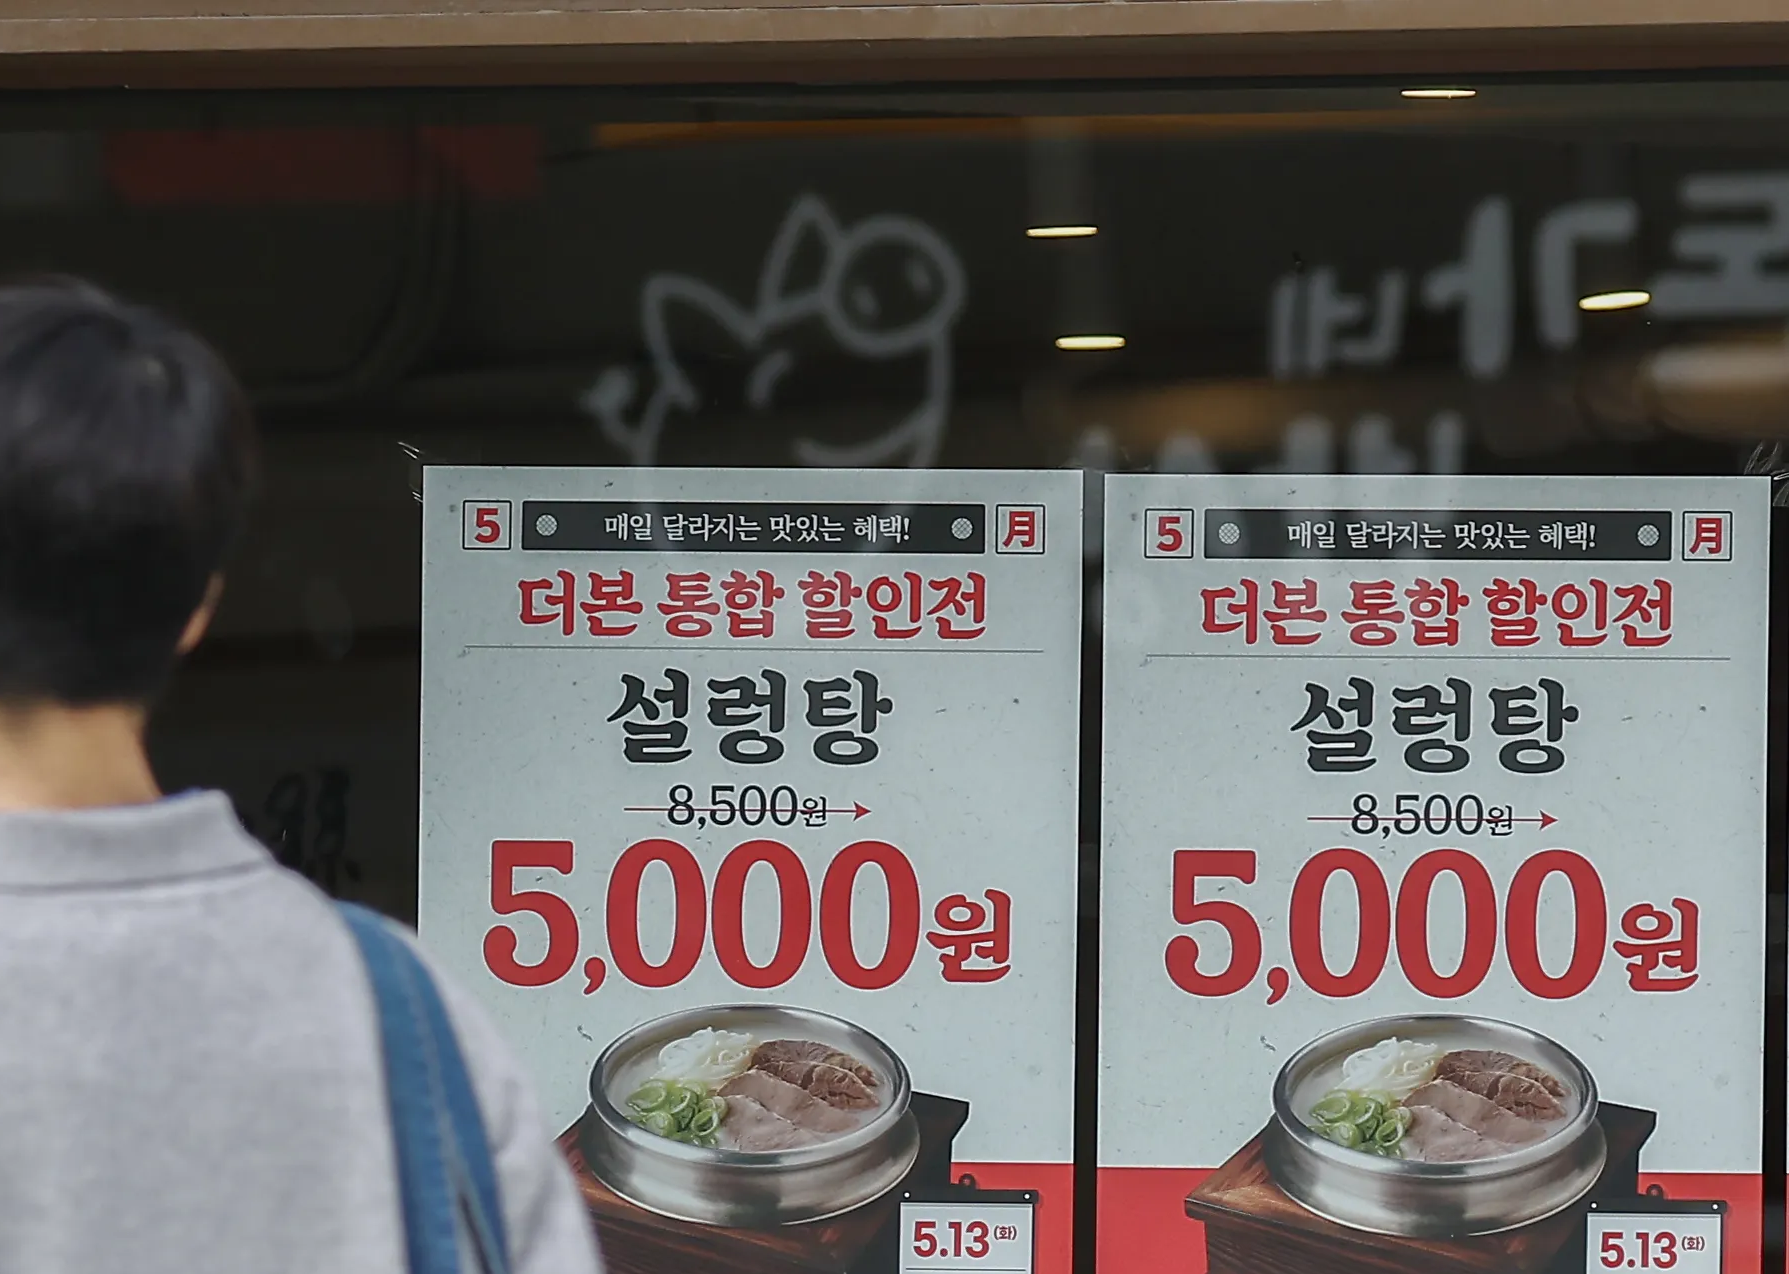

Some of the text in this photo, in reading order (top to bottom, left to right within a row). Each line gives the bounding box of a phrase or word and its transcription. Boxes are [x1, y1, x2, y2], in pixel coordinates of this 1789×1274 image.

[473, 507, 502, 542] 5
[604, 512, 912, 543] 매일 달라지는 맛있는 혜택!
[1002, 510, 1035, 547] 月
[1156, 516, 1183, 553] 5
[1287, 520, 1597, 551] 매일 달라지는 맛있는 혜택!
[1689, 517, 1724, 555] 月
[518, 570, 986, 641] 더본 통합 할인전
[1200, 578, 1672, 647] 더본 통합 할인전
[607, 669, 892, 765] 설렁탕
[1291, 677, 1579, 773] 설렁탕
[667, 785, 828, 828] 8,500원
[1351, 794, 1514, 837] 8,500원
[483, 839, 1011, 995] 5,000원
[1165, 848, 1699, 1005] 5,000원
